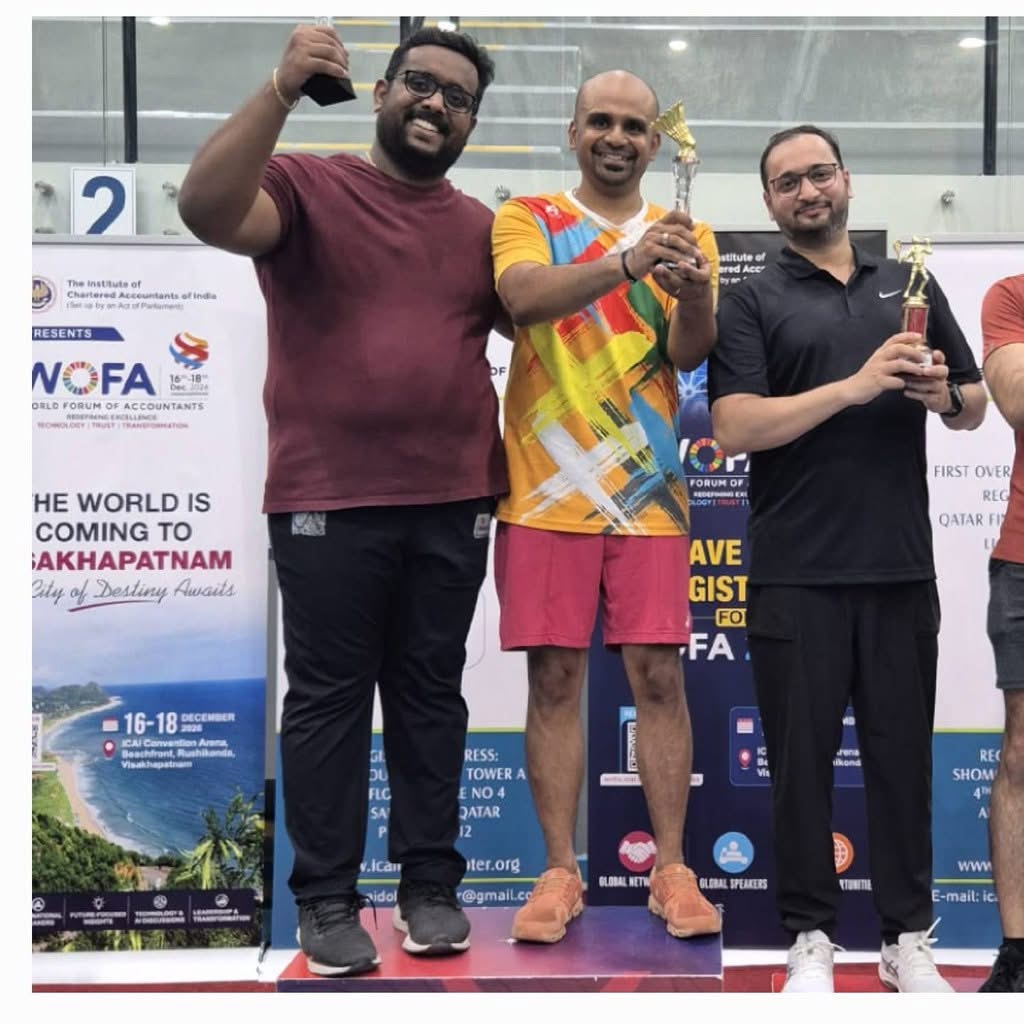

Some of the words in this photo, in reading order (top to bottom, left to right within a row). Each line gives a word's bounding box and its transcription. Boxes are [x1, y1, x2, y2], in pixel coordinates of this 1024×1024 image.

[82, 176, 126, 236] 2
[718, 252, 753, 262] stitute
[755, 252, 766, 262] of
[67, 280, 84, 288] The
[88, 280, 128, 288] Institute
[131, 280, 142, 288] of
[67, 290, 116, 299] Chartered
[118, 291, 179, 300] Accountants
[182, 292, 192, 300] of
[194, 292, 216, 300] India
[33, 328, 92, 338] RESENTS
[32, 402, 59, 410] ORLD
[63, 402, 101, 410] FORUM
[106, 402, 120, 410] OF
[124, 402, 204, 411] ACCOUNTANTS
[934, 465, 968, 478] FIRST
[975, 465, 1011, 478] OVER
[32, 493, 68, 512] HE
[77, 493, 179, 512] WORLD
[188, 492, 211, 512] IS
[939, 513, 984, 528] QATAR
[35, 522, 149, 542] COMING
[157, 522, 192, 542] TO
[689, 539, 742, 566] AVE
[32, 550, 232, 570] AKHAPATNAM
[70, 578, 88, 604] of
[93, 578, 168, 604] Destiny
[173, 578, 236, 598] Awaits
[689, 633, 735, 660] FA
[181, 713, 236, 722] DECEMBER
[144, 738, 197, 748] Convention
[464, 748, 499, 762] RESS:
[122, 760, 192, 770] Visakhapatnam
[466, 768, 512, 780] TOWER
[516, 768, 526, 780] A
[952, 768, 997, 782] SHOM
[472, 787, 494, 800] NO
[497, 787, 506, 799] 4
[599, 876, 626, 888] GLOBAL
[700, 878, 728, 890] GLOBAL
[730, 878, 768, 890] SPEAKERS
[931, 890, 980, 902] E-mail:
